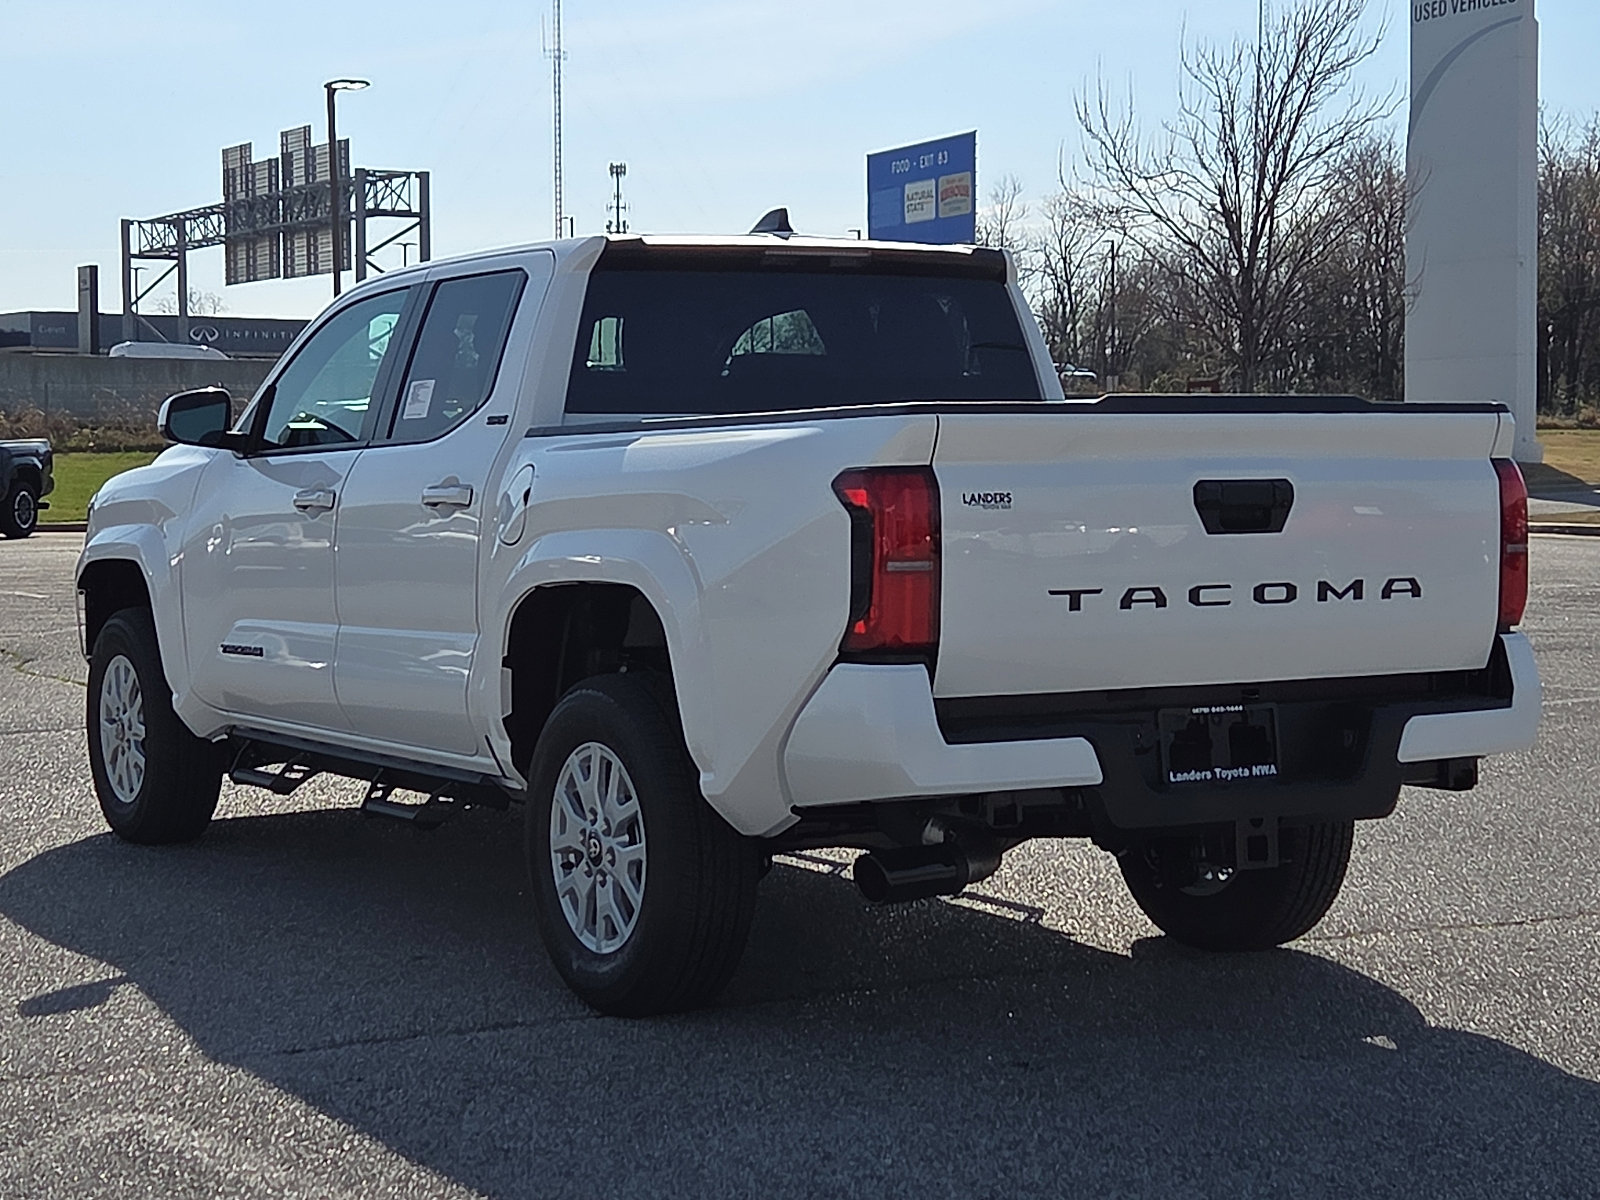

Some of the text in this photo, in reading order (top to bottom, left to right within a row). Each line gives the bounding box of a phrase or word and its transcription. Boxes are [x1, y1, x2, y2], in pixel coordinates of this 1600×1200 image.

[1414, 0, 1517, 22] USED VEHIC
[892, 159, 910, 174] FOOD
[920, 153, 934, 168] EXIT
[906, 202, 925, 214] STATE
[225, 328, 294, 340] INFINITI
[962, 492, 1012, 506] LANDERS
[1047, 576, 1422, 612] TACOMA
[1169, 765, 1277, 782] Landers Toyota NWA
